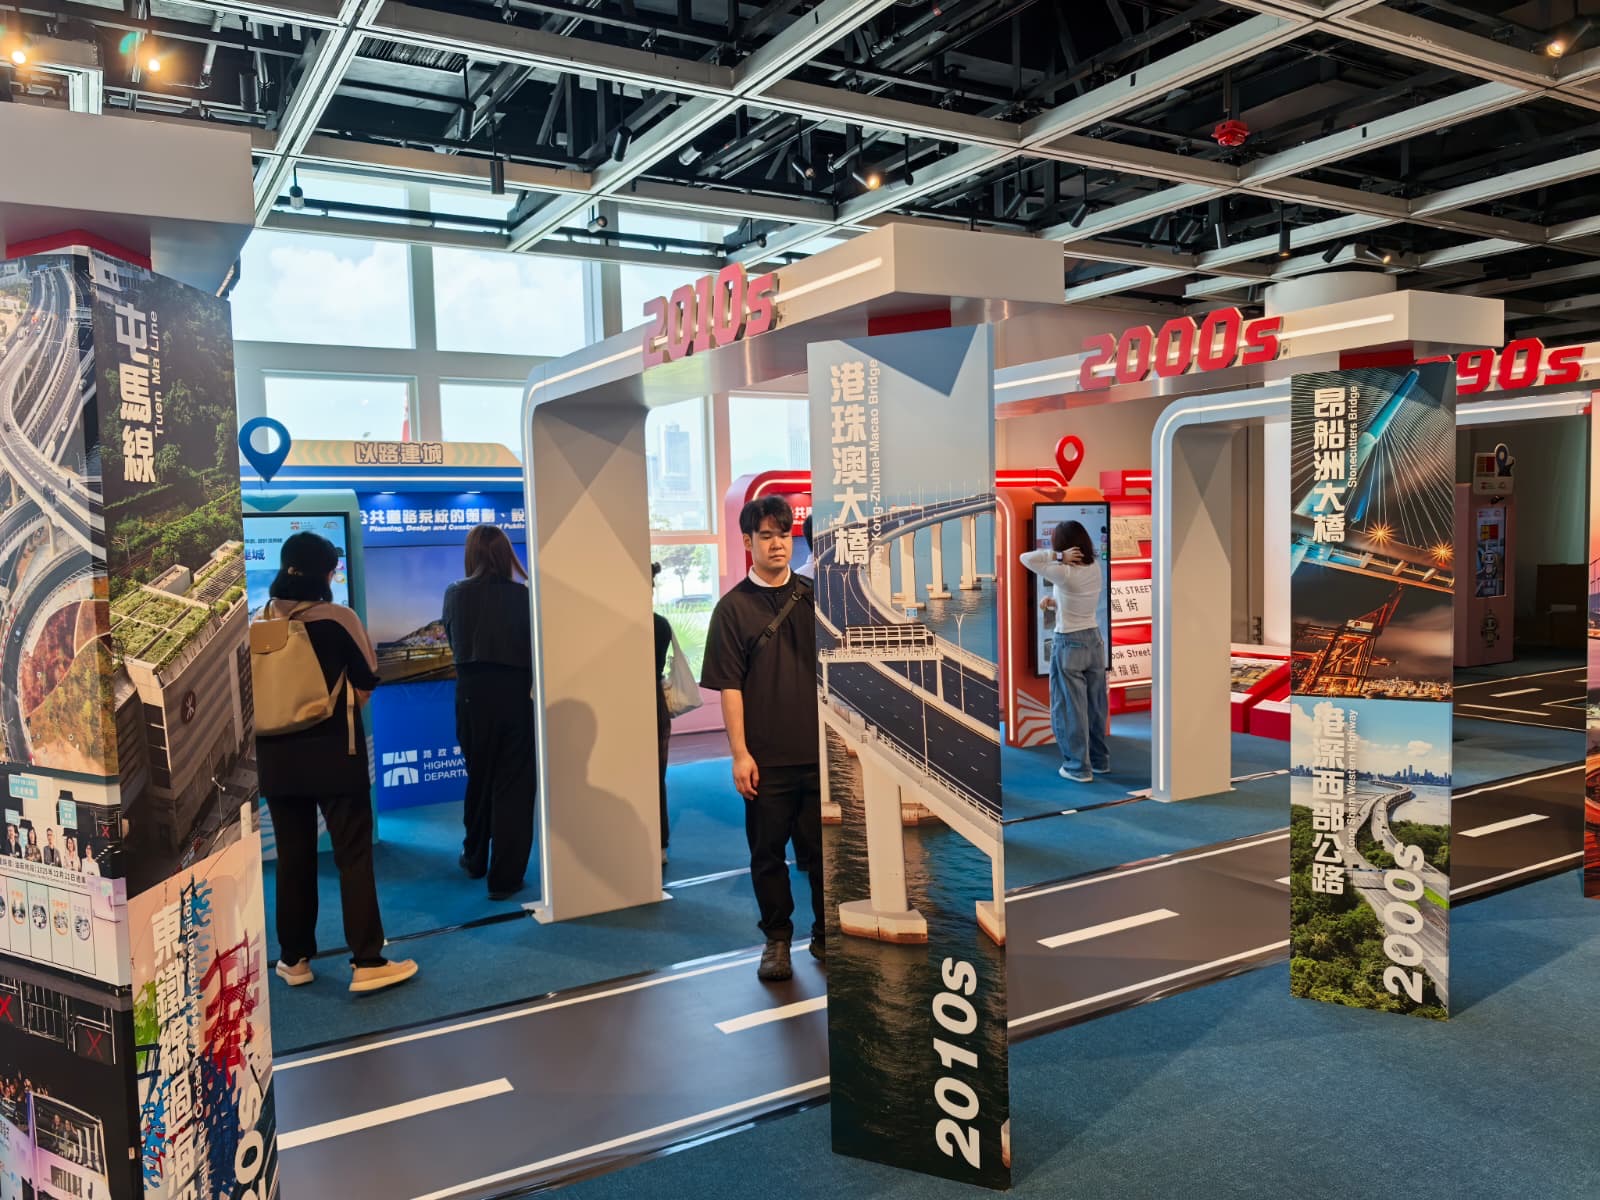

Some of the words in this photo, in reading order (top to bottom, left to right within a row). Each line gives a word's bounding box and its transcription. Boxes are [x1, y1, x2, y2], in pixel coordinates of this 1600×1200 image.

[150, 311, 160, 351] Line
[643, 262, 778, 369] 2010s
[151, 358, 161, 385] Ma
[1079, 307, 1283, 391] 2000s
[1416, 337, 1584, 395] 90s
[868, 359, 881, 405] Bridge
[1348, 385, 1361, 421] Bridge
[154, 391, 164, 438] Tuen
[830, 361, 869, 566] 港珠澳大橋
[869, 408, 884, 541] Kong-Zhuhai-Macao
[1313, 388, 1345, 543] 昂船洲大橋
[1347, 422, 1358, 488] Stonecutters
[406, 525, 432, 533] Design
[872, 545, 884, 578] Hong
[1111, 586, 1124, 595] OK
[1125, 584, 1152, 595] STREET
[1111, 650, 1125, 660] ook
[1127, 647, 1152, 658] Street
[1347, 709, 1359, 752] Highway
[423, 757, 466, 771] HIGHWA
[1347, 753, 1357, 794] Western
[1312, 702, 1344, 895] 港深西部公路
[1347, 796, 1356, 825] Sham
[1347, 827, 1358, 853] Kong
[1383, 842, 1424, 1004] 2000s
[932, 957, 981, 1169] 2010s
[234, 1081, 267, 1200] 0s
